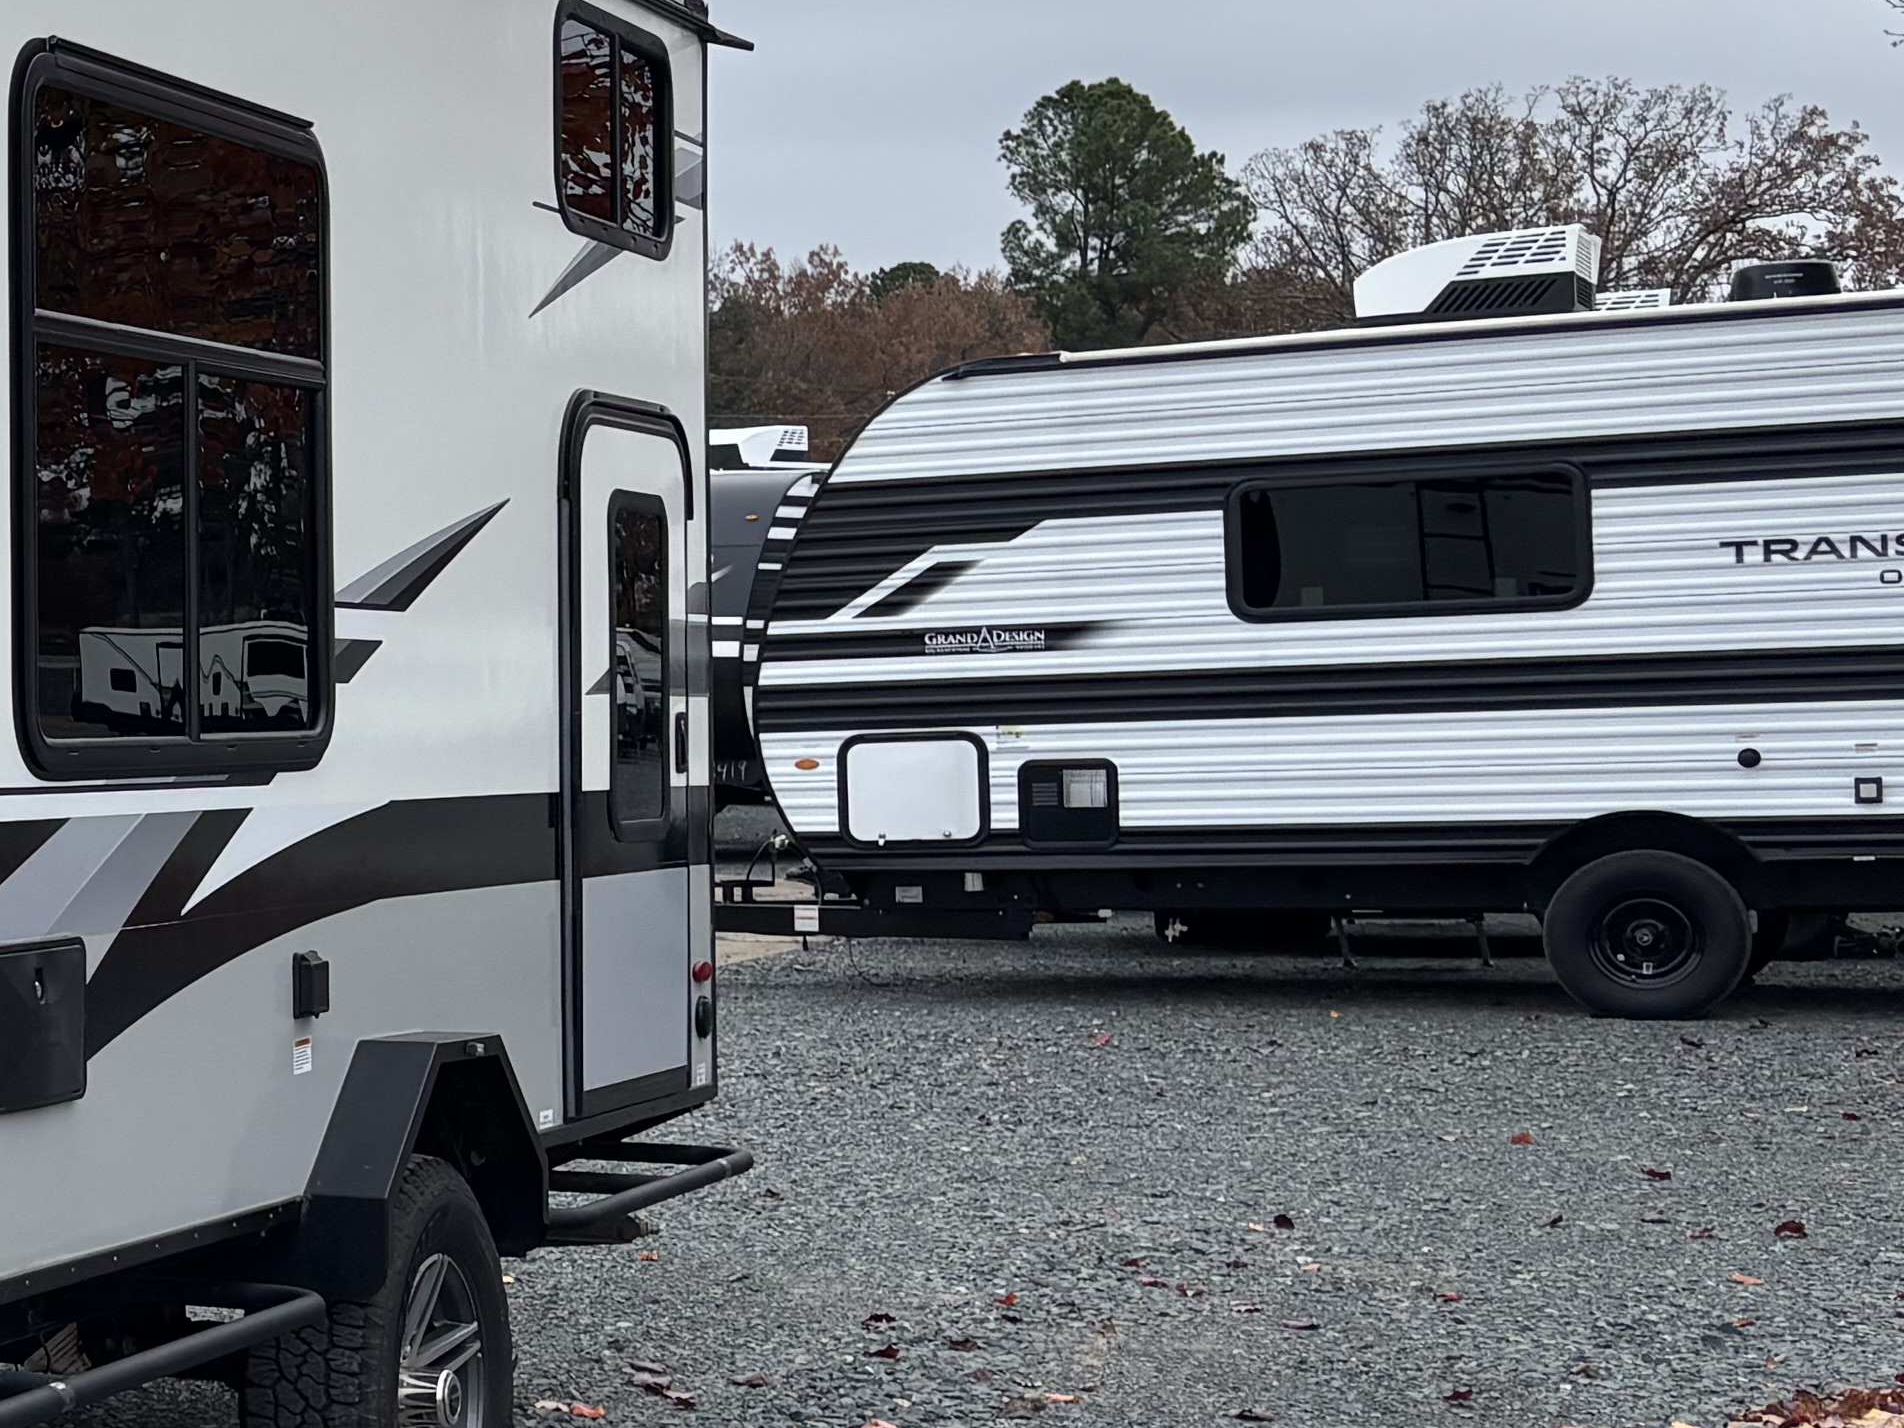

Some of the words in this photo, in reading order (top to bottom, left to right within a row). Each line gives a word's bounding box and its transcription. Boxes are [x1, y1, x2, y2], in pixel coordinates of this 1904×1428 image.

[1719, 533, 1904, 564] TRAN
[924, 633, 978, 646] GRAND
[992, 629, 1045, 643] DESIGN
[713, 760, 747, 781] 419
